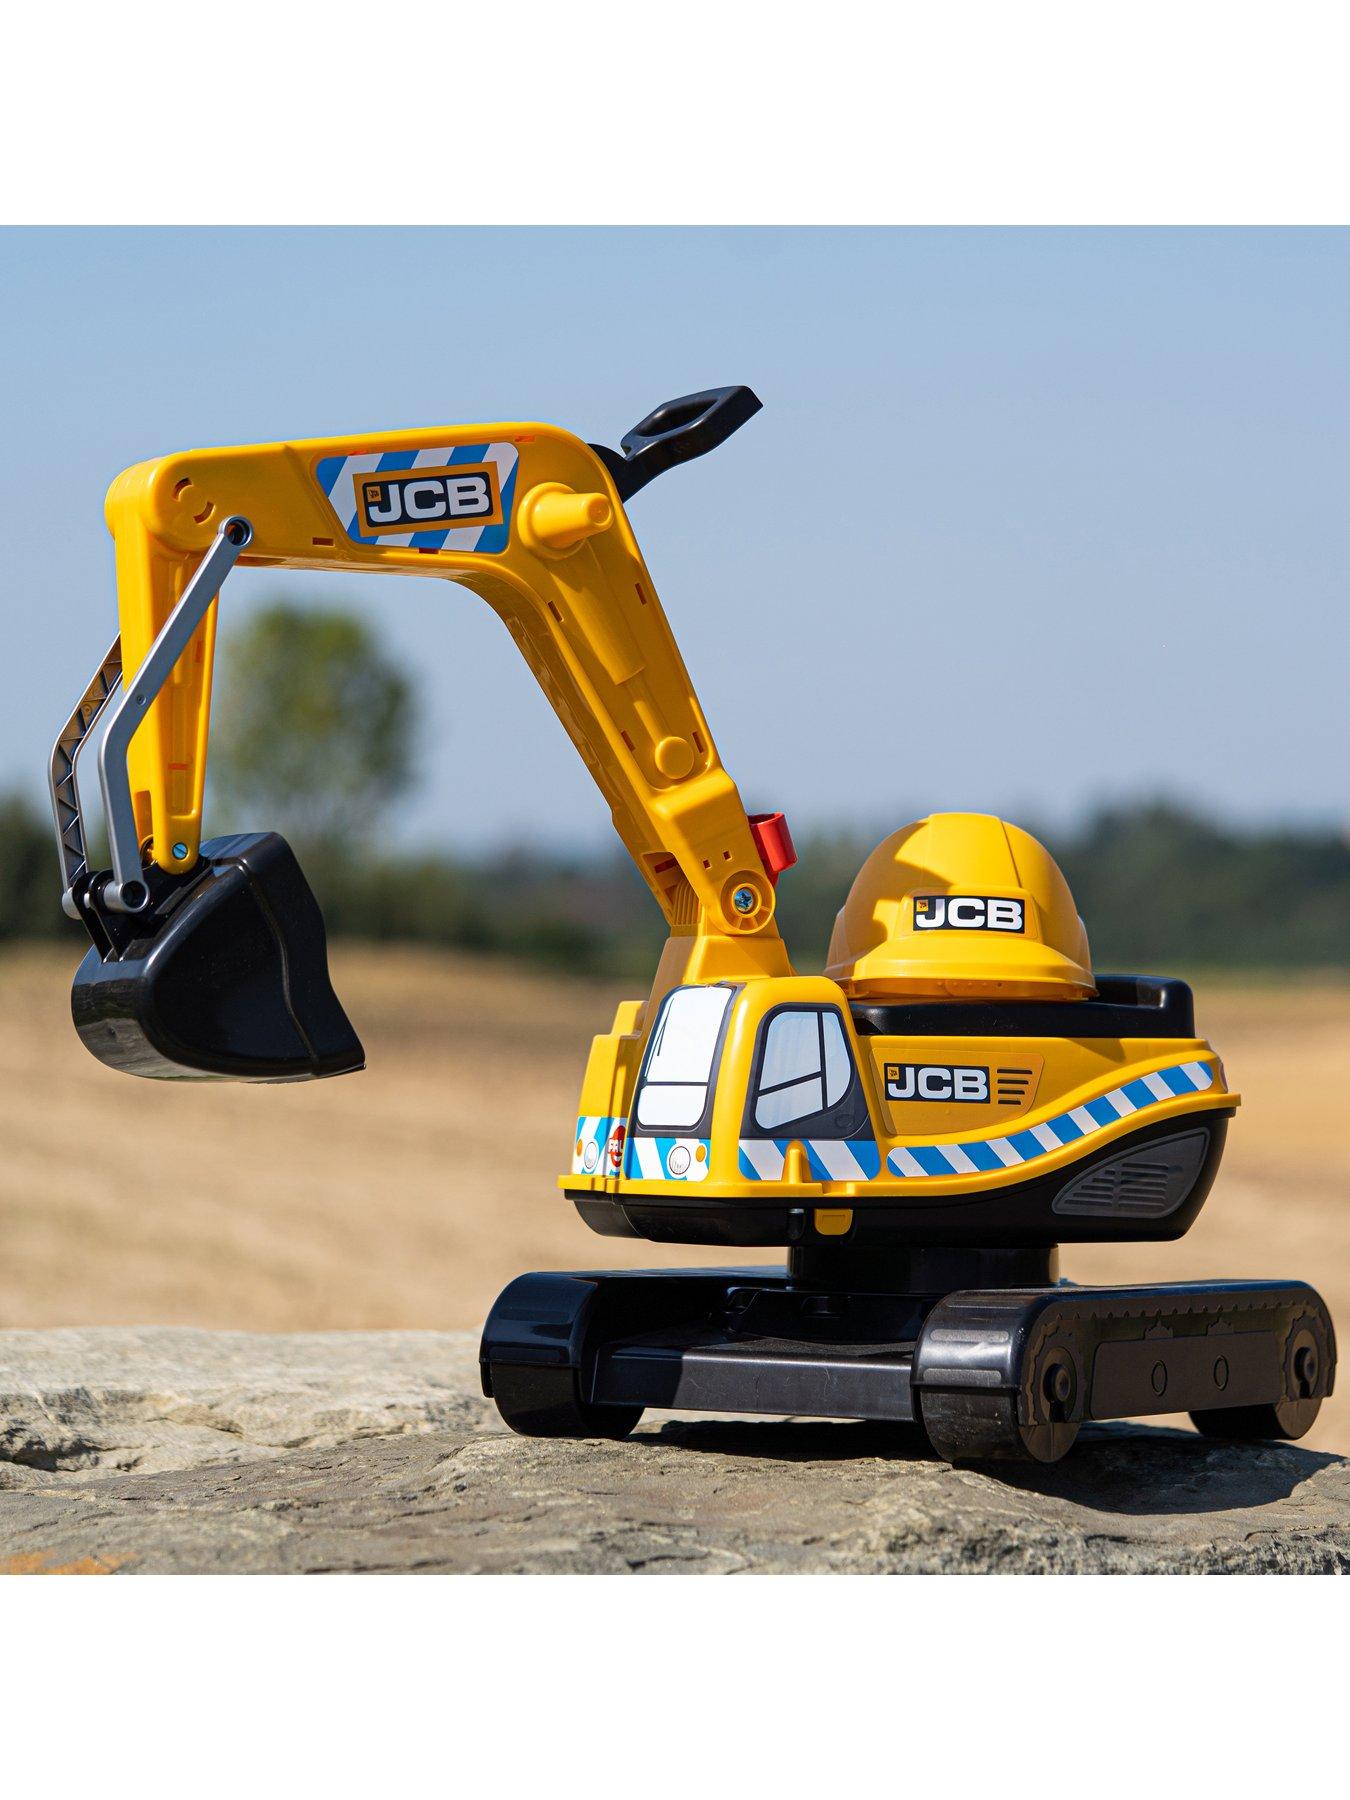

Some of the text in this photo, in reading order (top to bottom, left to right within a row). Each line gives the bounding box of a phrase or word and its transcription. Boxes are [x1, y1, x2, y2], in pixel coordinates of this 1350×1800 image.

[367, 476, 490, 523] JCB
[915, 897, 1023, 930] JCB
[887, 1067, 988, 1100] JCB
